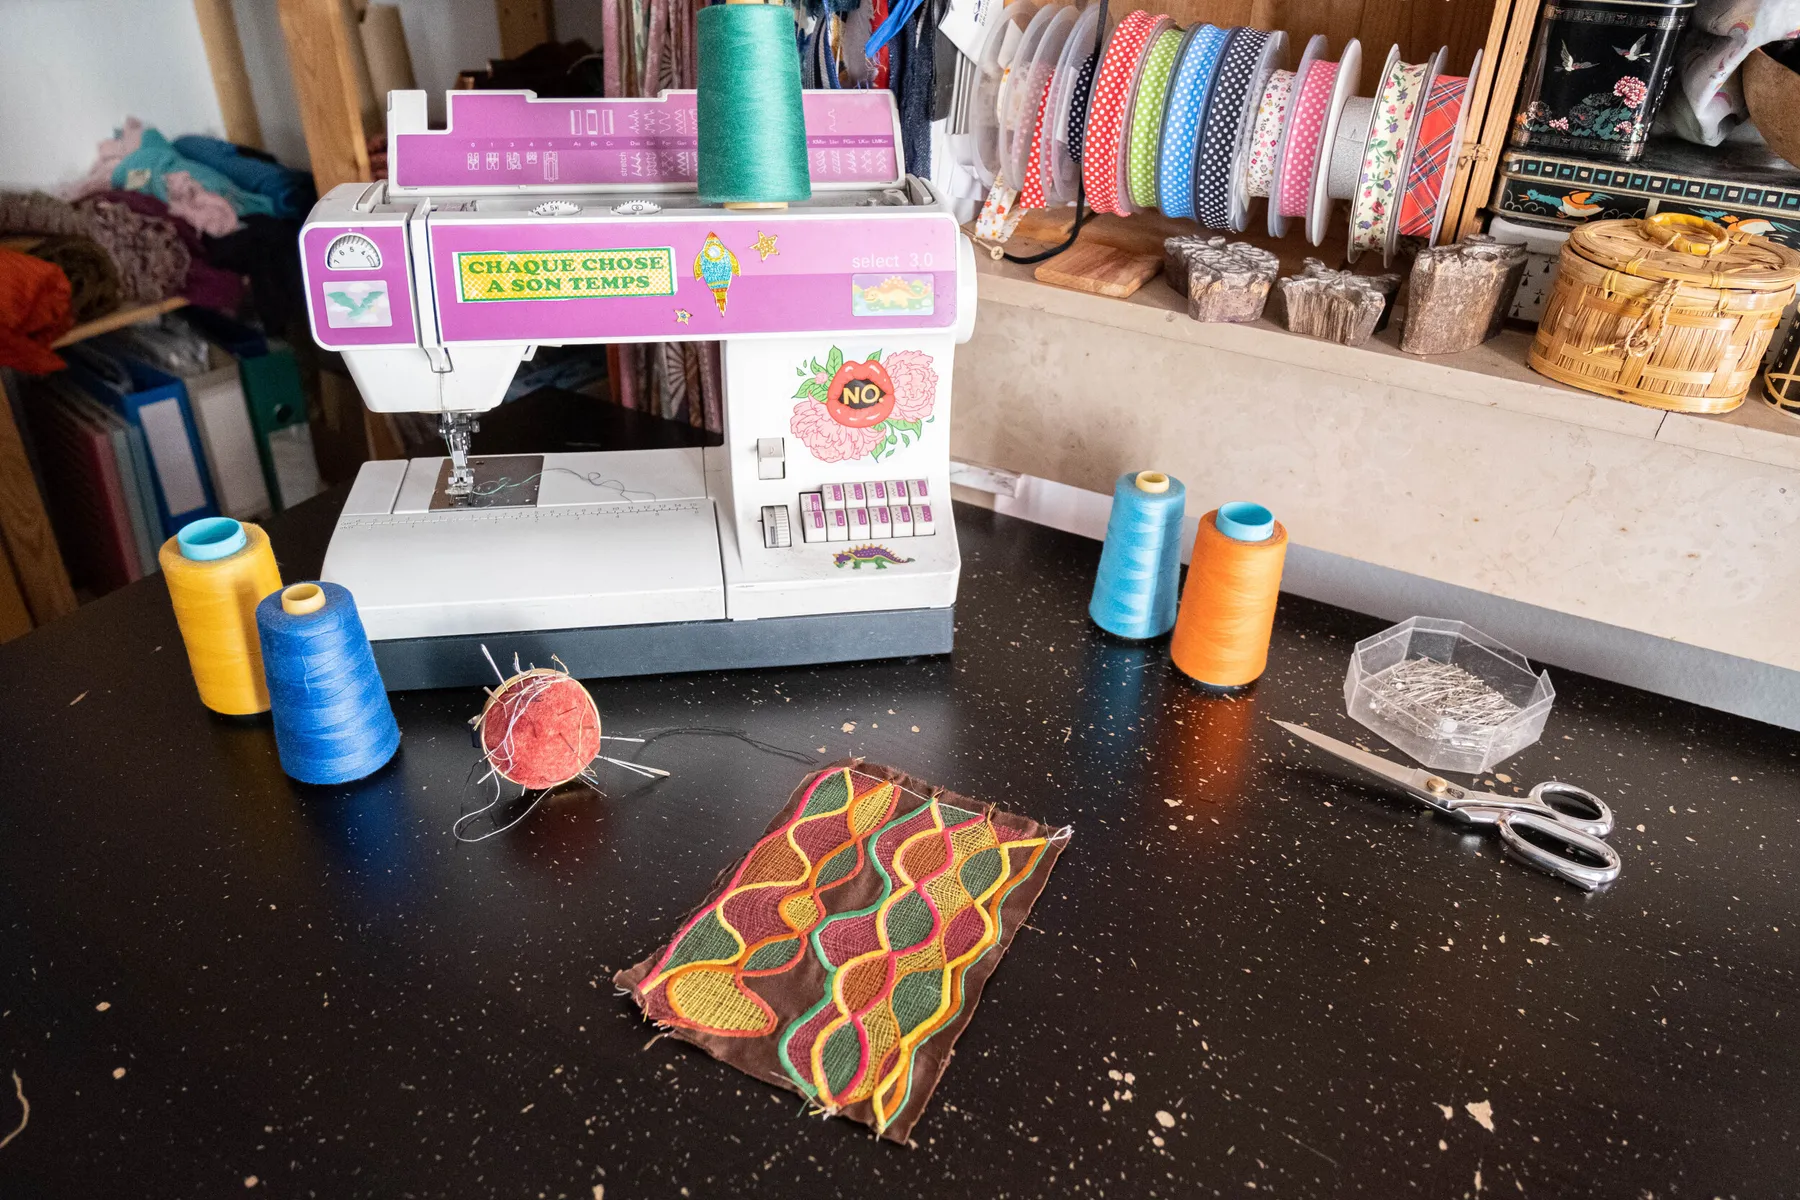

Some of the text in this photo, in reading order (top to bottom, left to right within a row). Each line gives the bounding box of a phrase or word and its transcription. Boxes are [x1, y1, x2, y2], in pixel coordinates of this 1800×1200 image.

[619, 152, 628, 176] stretch
[468, 256, 664, 276] CHAQUE CHOSE
[852, 252, 933, 268] select 3.0
[487, 275, 650, 293] A SON TEMPS
[843, 384, 880, 405] NO
